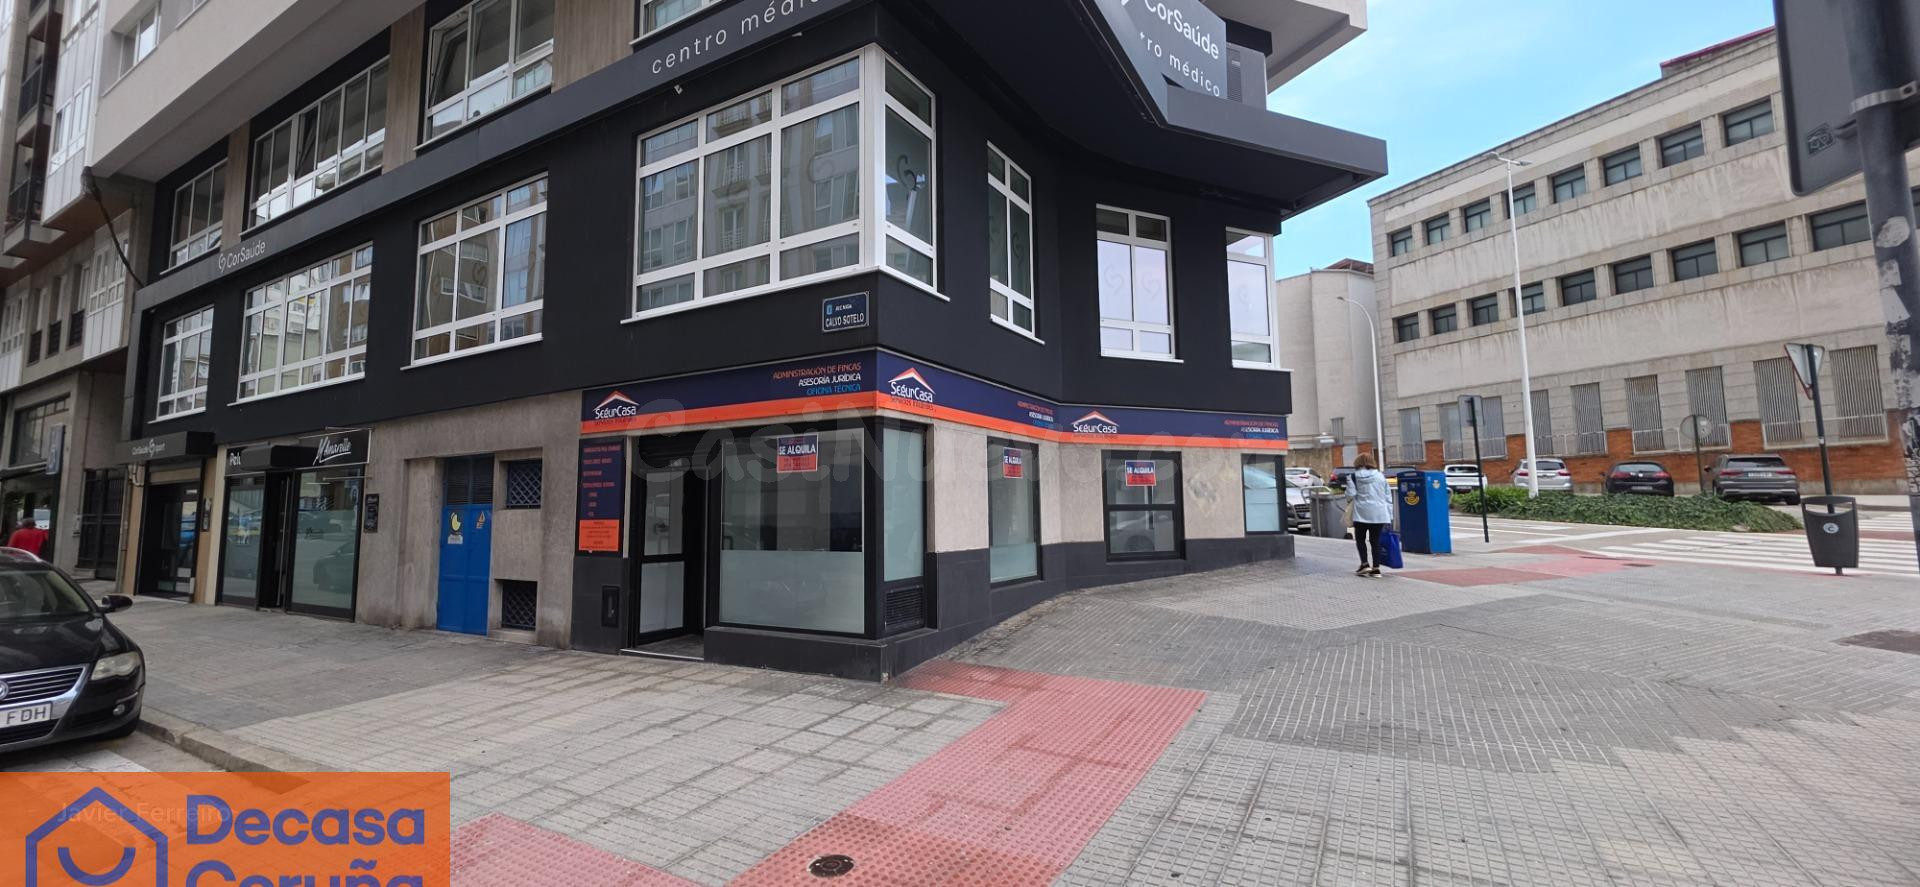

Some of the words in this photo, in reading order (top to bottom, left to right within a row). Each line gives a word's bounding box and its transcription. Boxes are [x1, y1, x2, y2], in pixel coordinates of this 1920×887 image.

[652, 29, 727, 74] centro
[1169, 54, 1220, 97] médico
[825, 316, 842, 328] CALVO
[843, 312, 864, 325] SOTELO
[773, 366, 827, 379] ADMINISTRACIÓN
[827, 364, 836, 374] DE
[837, 361, 862, 372] FINCAS
[798, 375, 831, 387] ASESORÍA
[831, 372, 862, 384] JURÍDICA
[890, 381, 933, 403] SegurCasa
[594, 405, 637, 420] SegurCasa
[1073, 423, 1117, 434] SegurCasa
[779, 446, 786, 456] SE
[787, 443, 816, 455] ALQUILA
